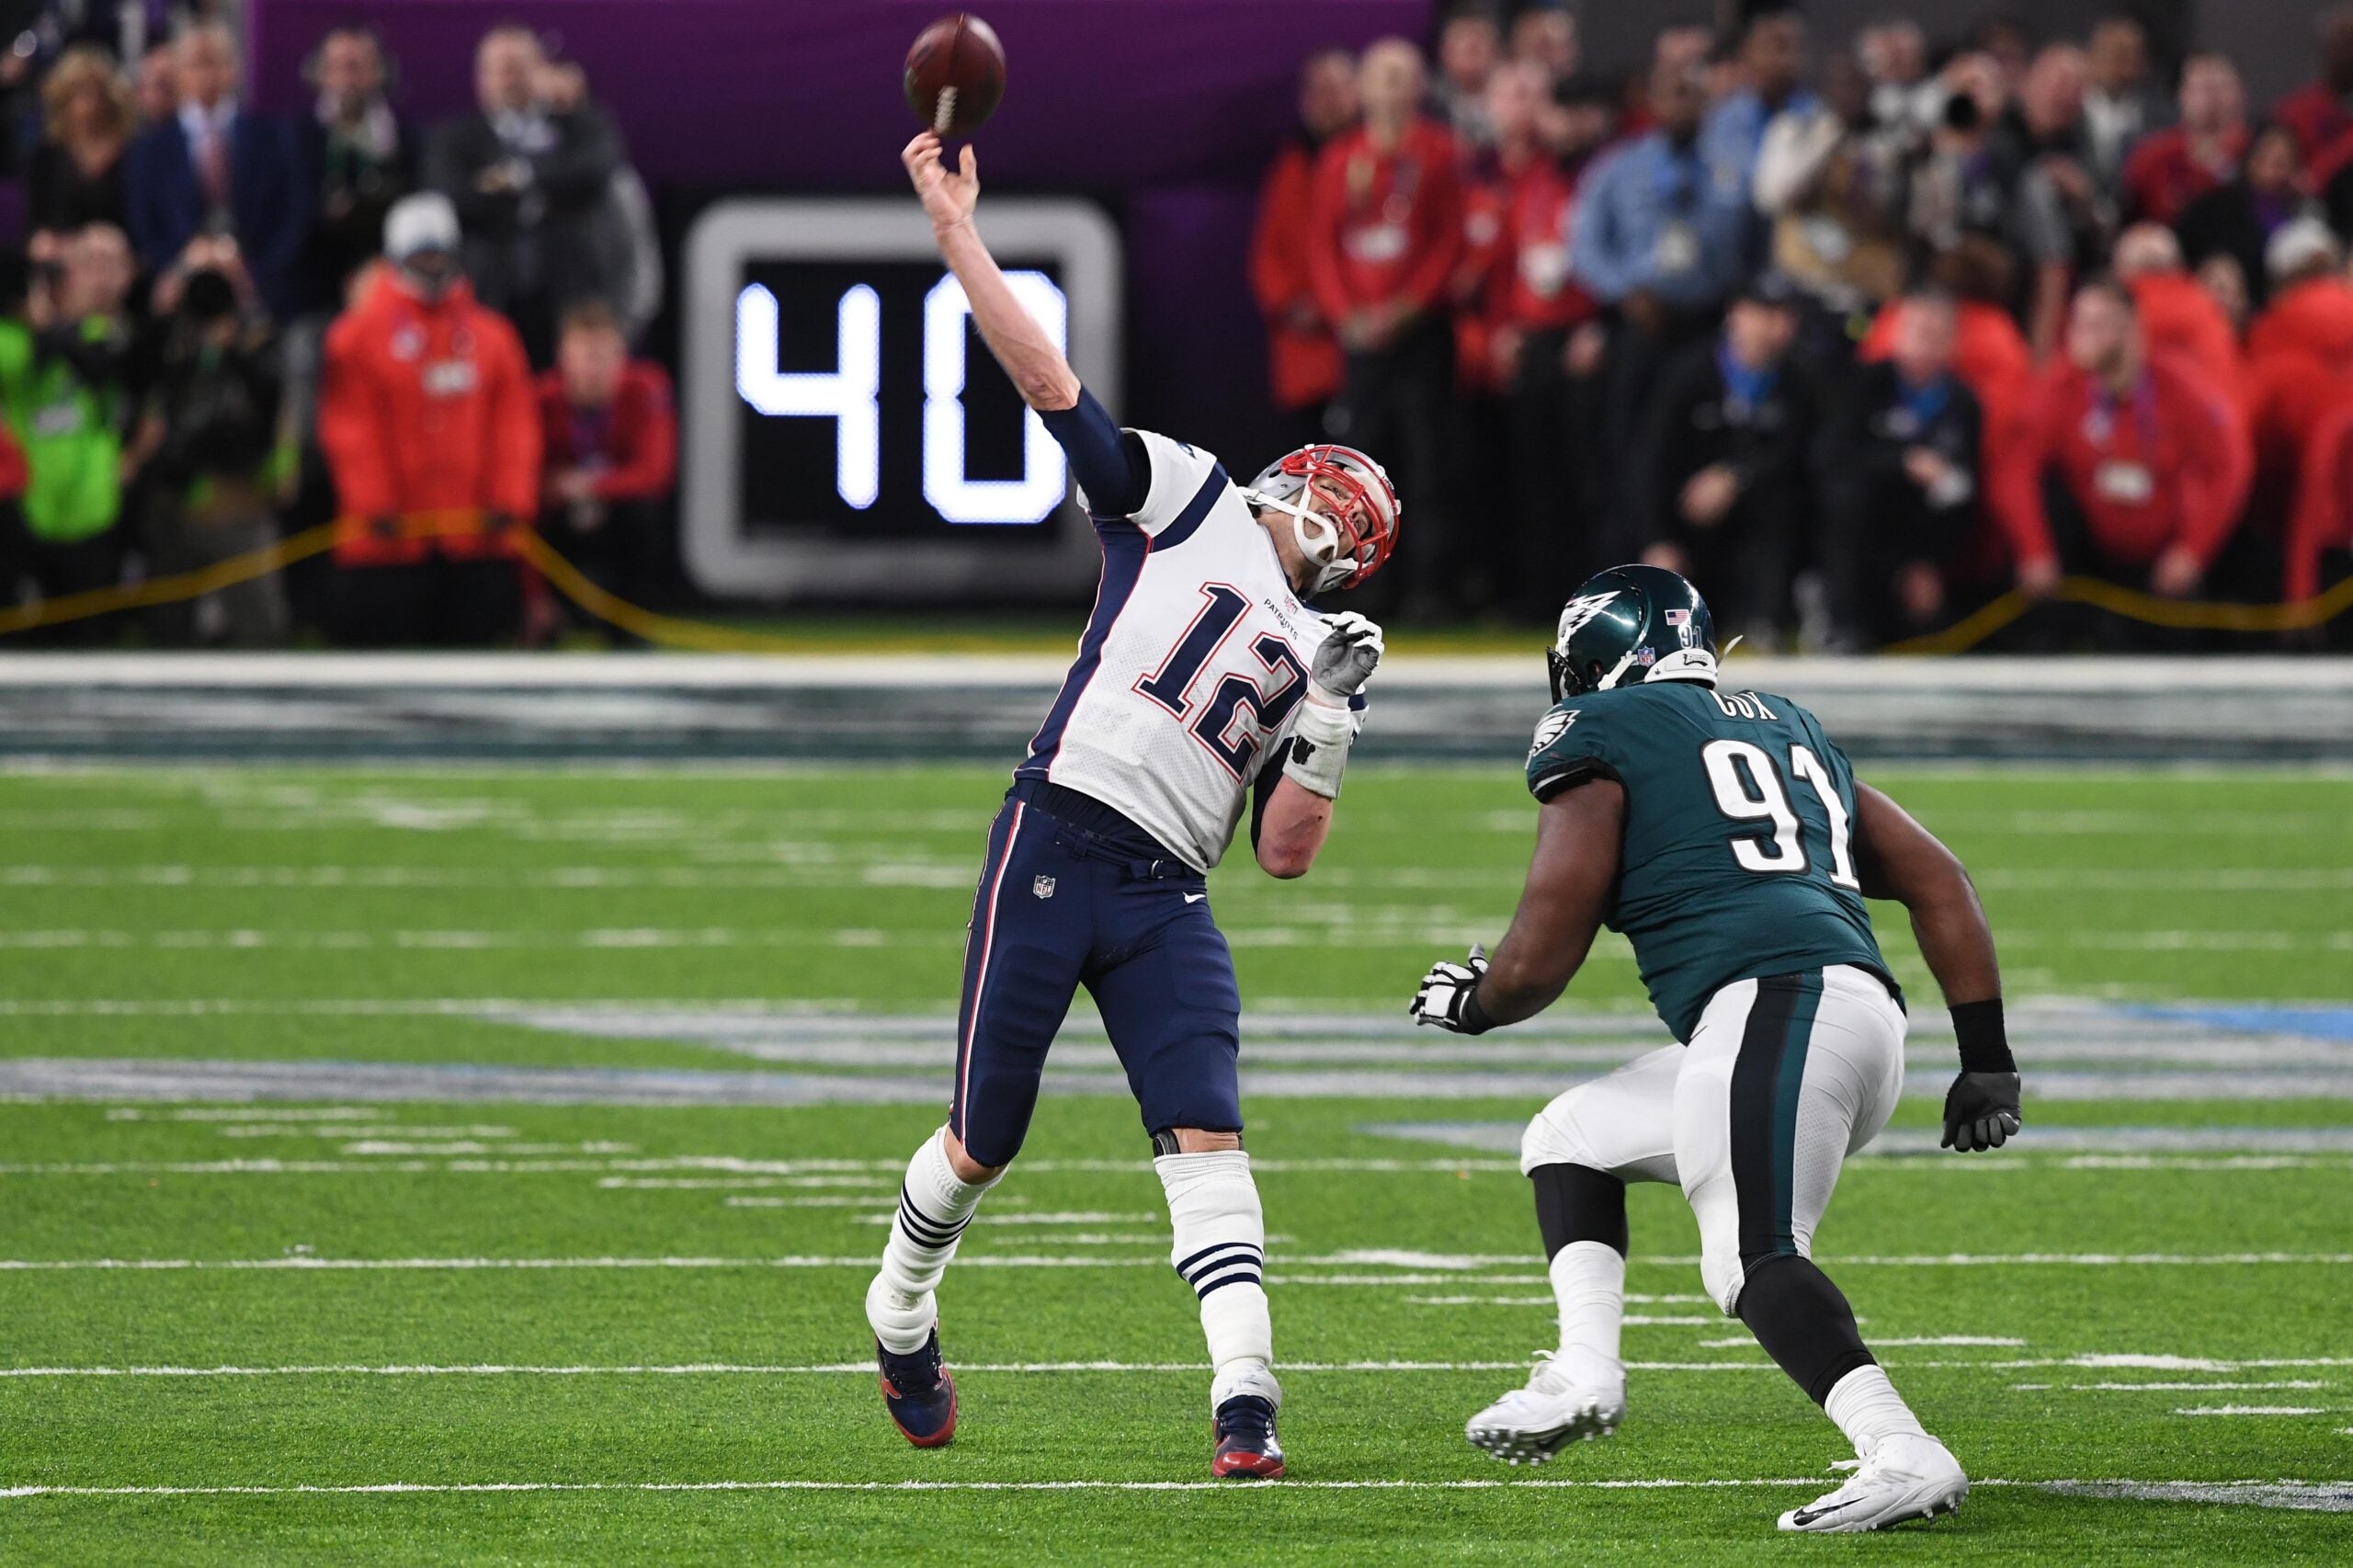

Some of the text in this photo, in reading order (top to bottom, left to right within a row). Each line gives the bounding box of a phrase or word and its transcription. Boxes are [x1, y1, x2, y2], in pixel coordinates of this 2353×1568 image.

[736, 270, 1067, 524] 40
[1264, 598, 1298, 640] PATRIOTS
[1677, 625, 1703, 649] 91
[1131, 582, 1312, 784] 12
[1708, 690, 1779, 721] COX
[1700, 739, 1860, 895] 91
[1036, 883, 1052, 894] NFL
